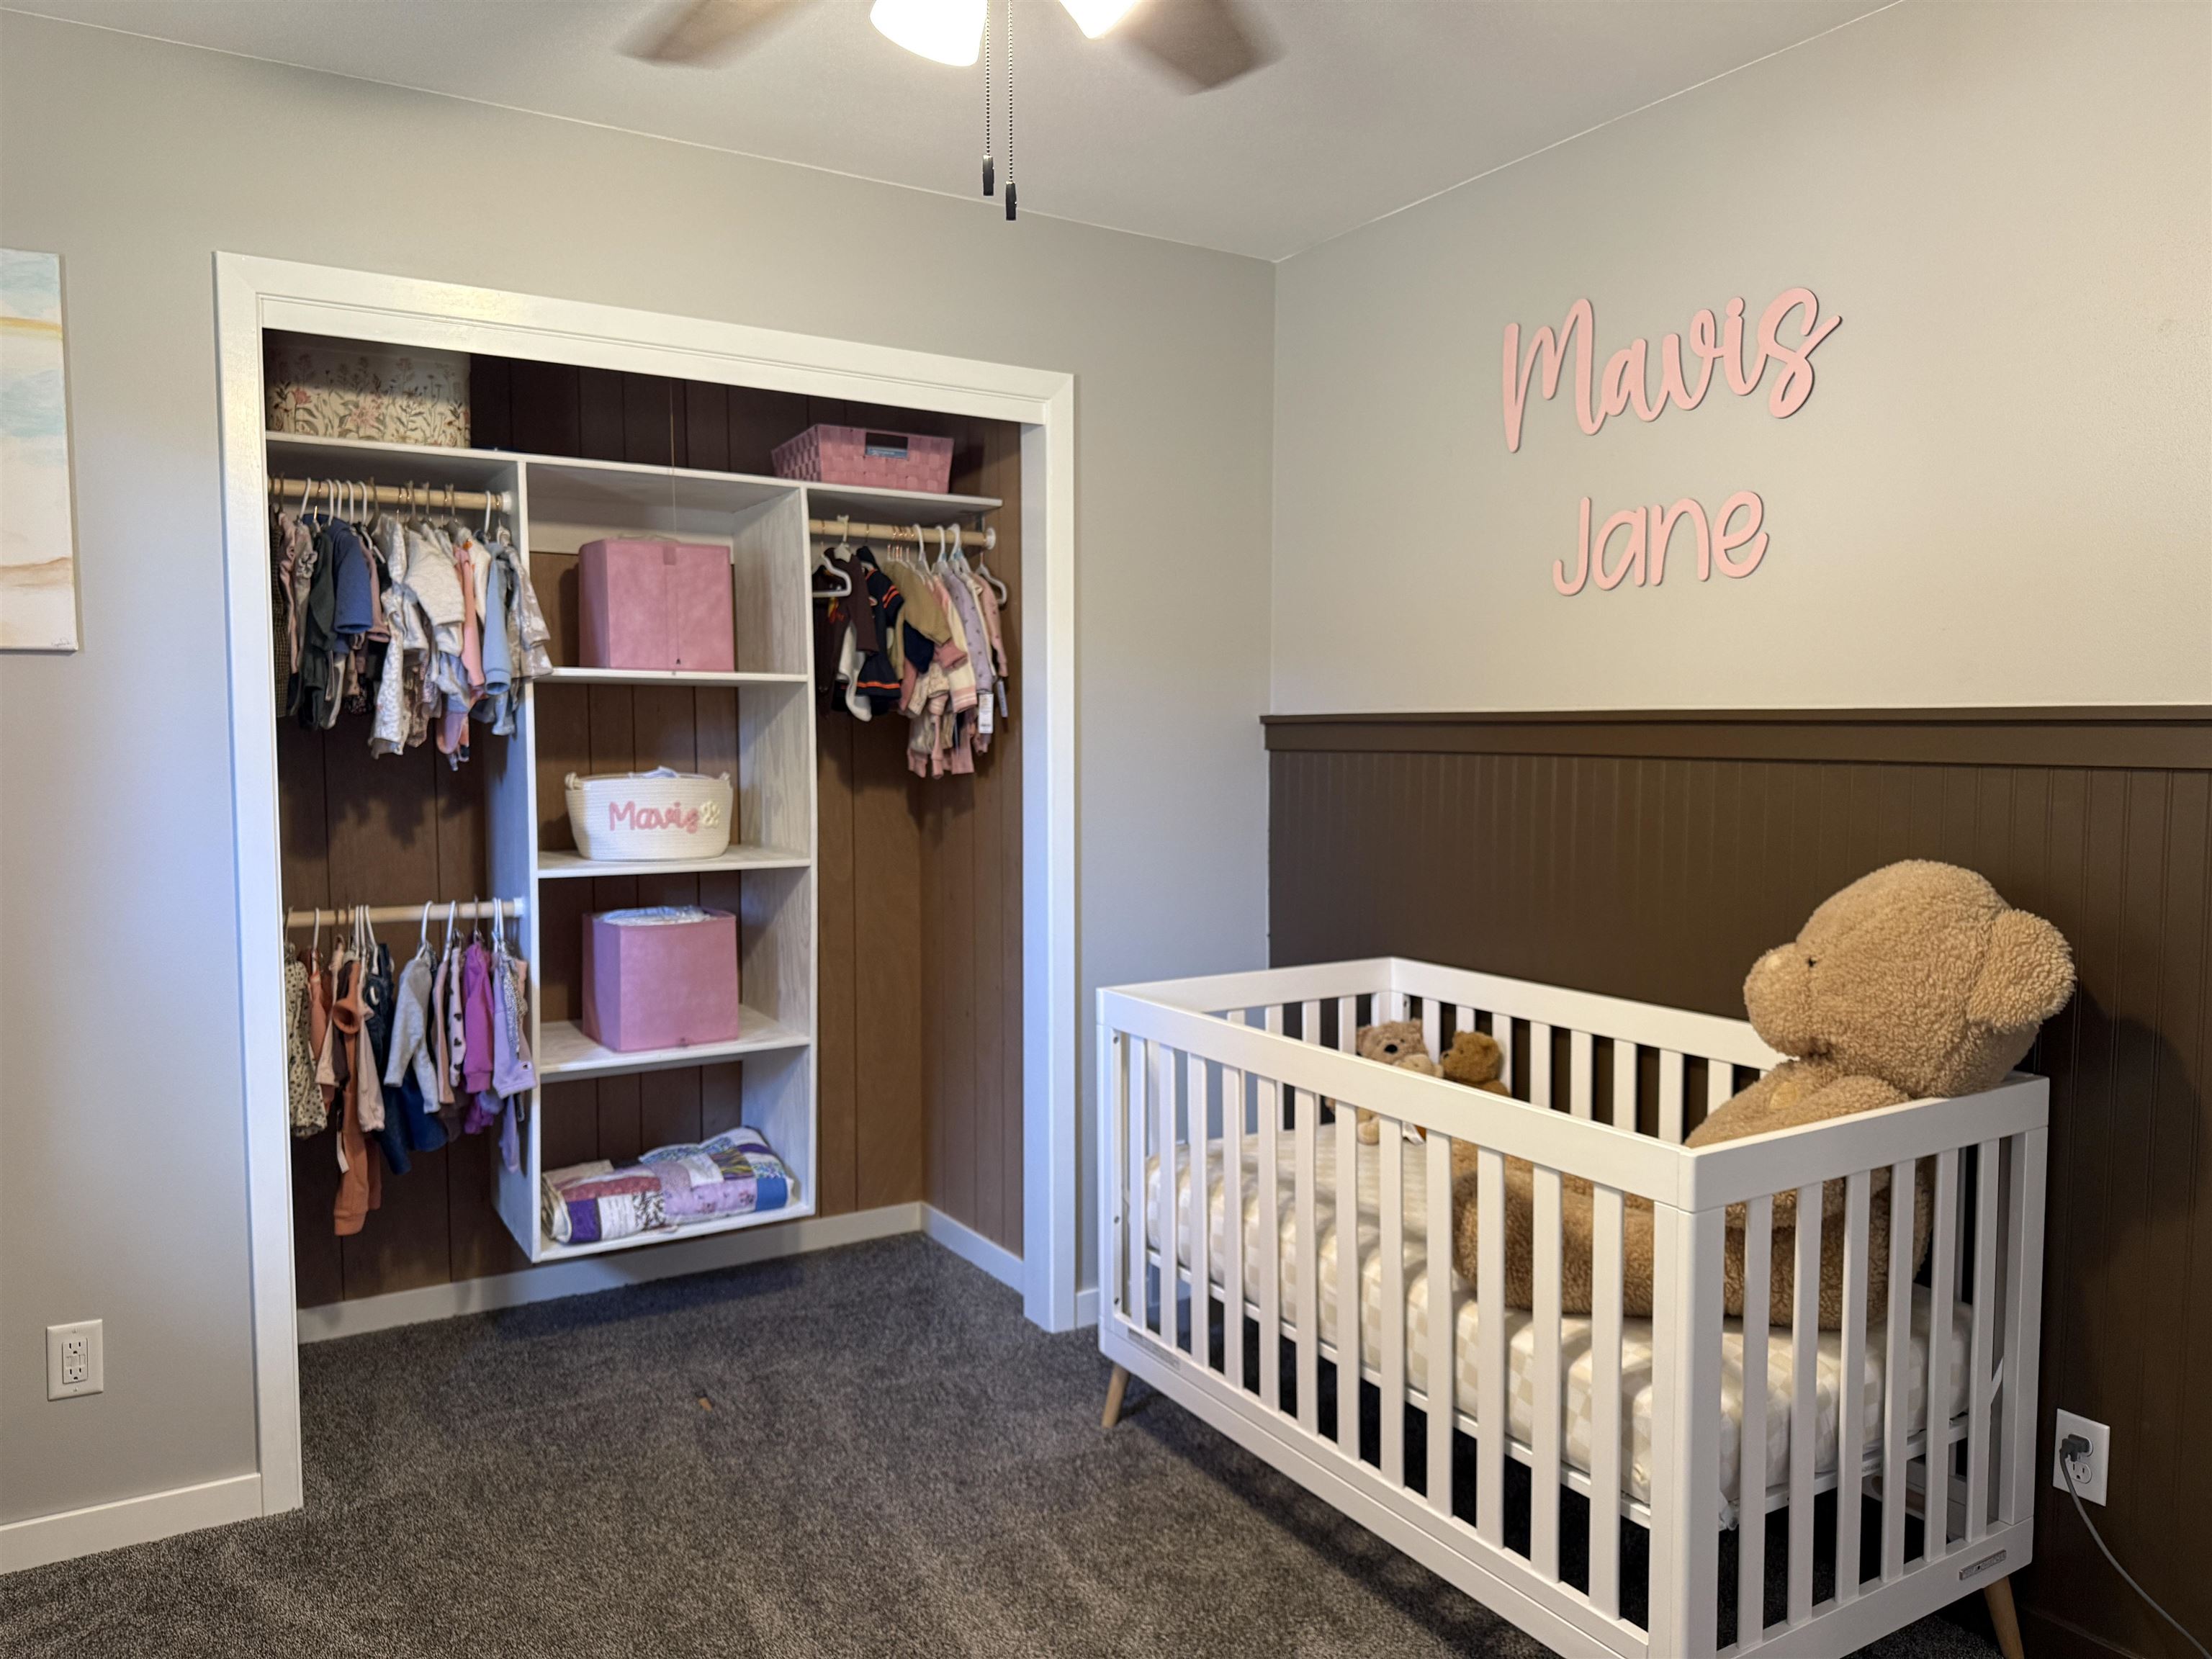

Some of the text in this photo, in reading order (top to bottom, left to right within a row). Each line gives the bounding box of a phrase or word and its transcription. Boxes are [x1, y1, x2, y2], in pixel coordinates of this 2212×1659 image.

[1503, 287, 1842, 452] Mavis
[1553, 491, 1768, 596] Jane
[609, 801, 699, 834] Mavis
